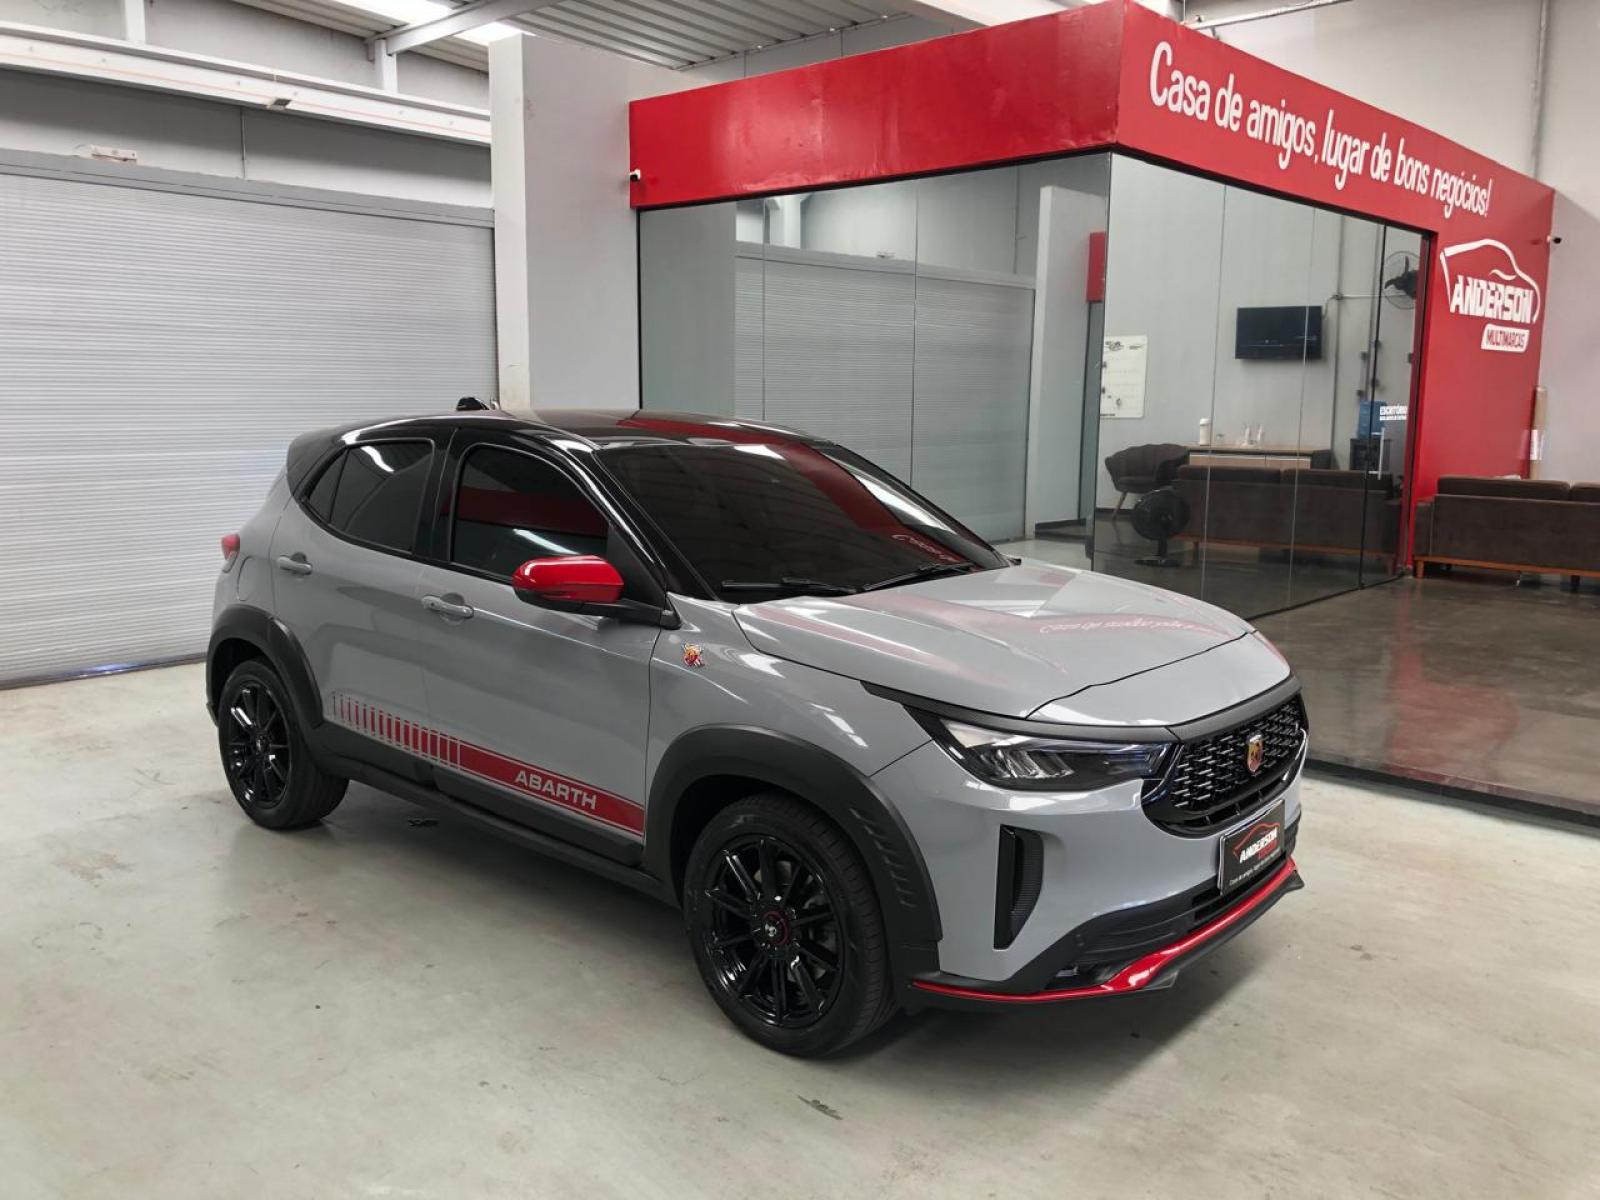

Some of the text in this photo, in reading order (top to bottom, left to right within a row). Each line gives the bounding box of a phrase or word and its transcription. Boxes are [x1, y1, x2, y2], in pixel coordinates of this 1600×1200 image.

[1150, 41, 1492, 219] Casa de amigos, lugar de bons negócios!
[1450, 275, 1533, 323] ANDERSON
[1486, 329, 1525, 348] MULTIMARCAS
[515, 770, 597, 810] ABARTH
